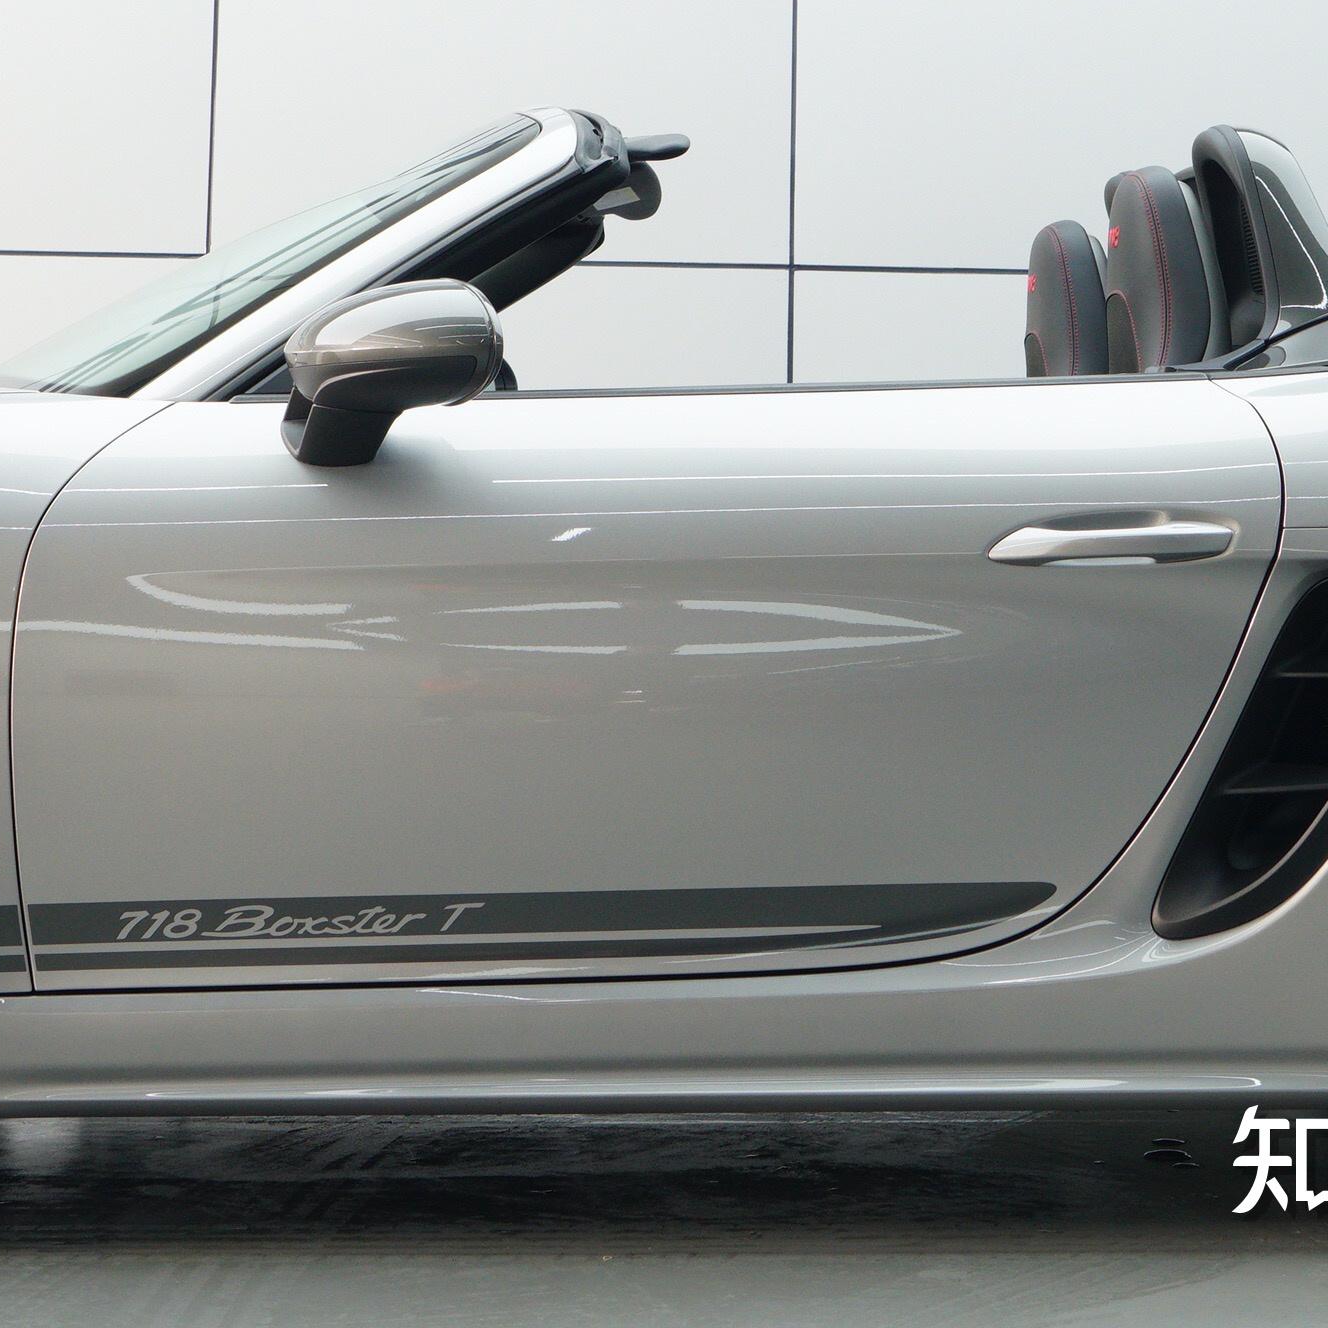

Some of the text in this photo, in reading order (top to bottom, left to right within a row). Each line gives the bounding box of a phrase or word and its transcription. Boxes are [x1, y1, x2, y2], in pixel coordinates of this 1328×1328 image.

[116, 902, 486, 940] 718 Boxster T
